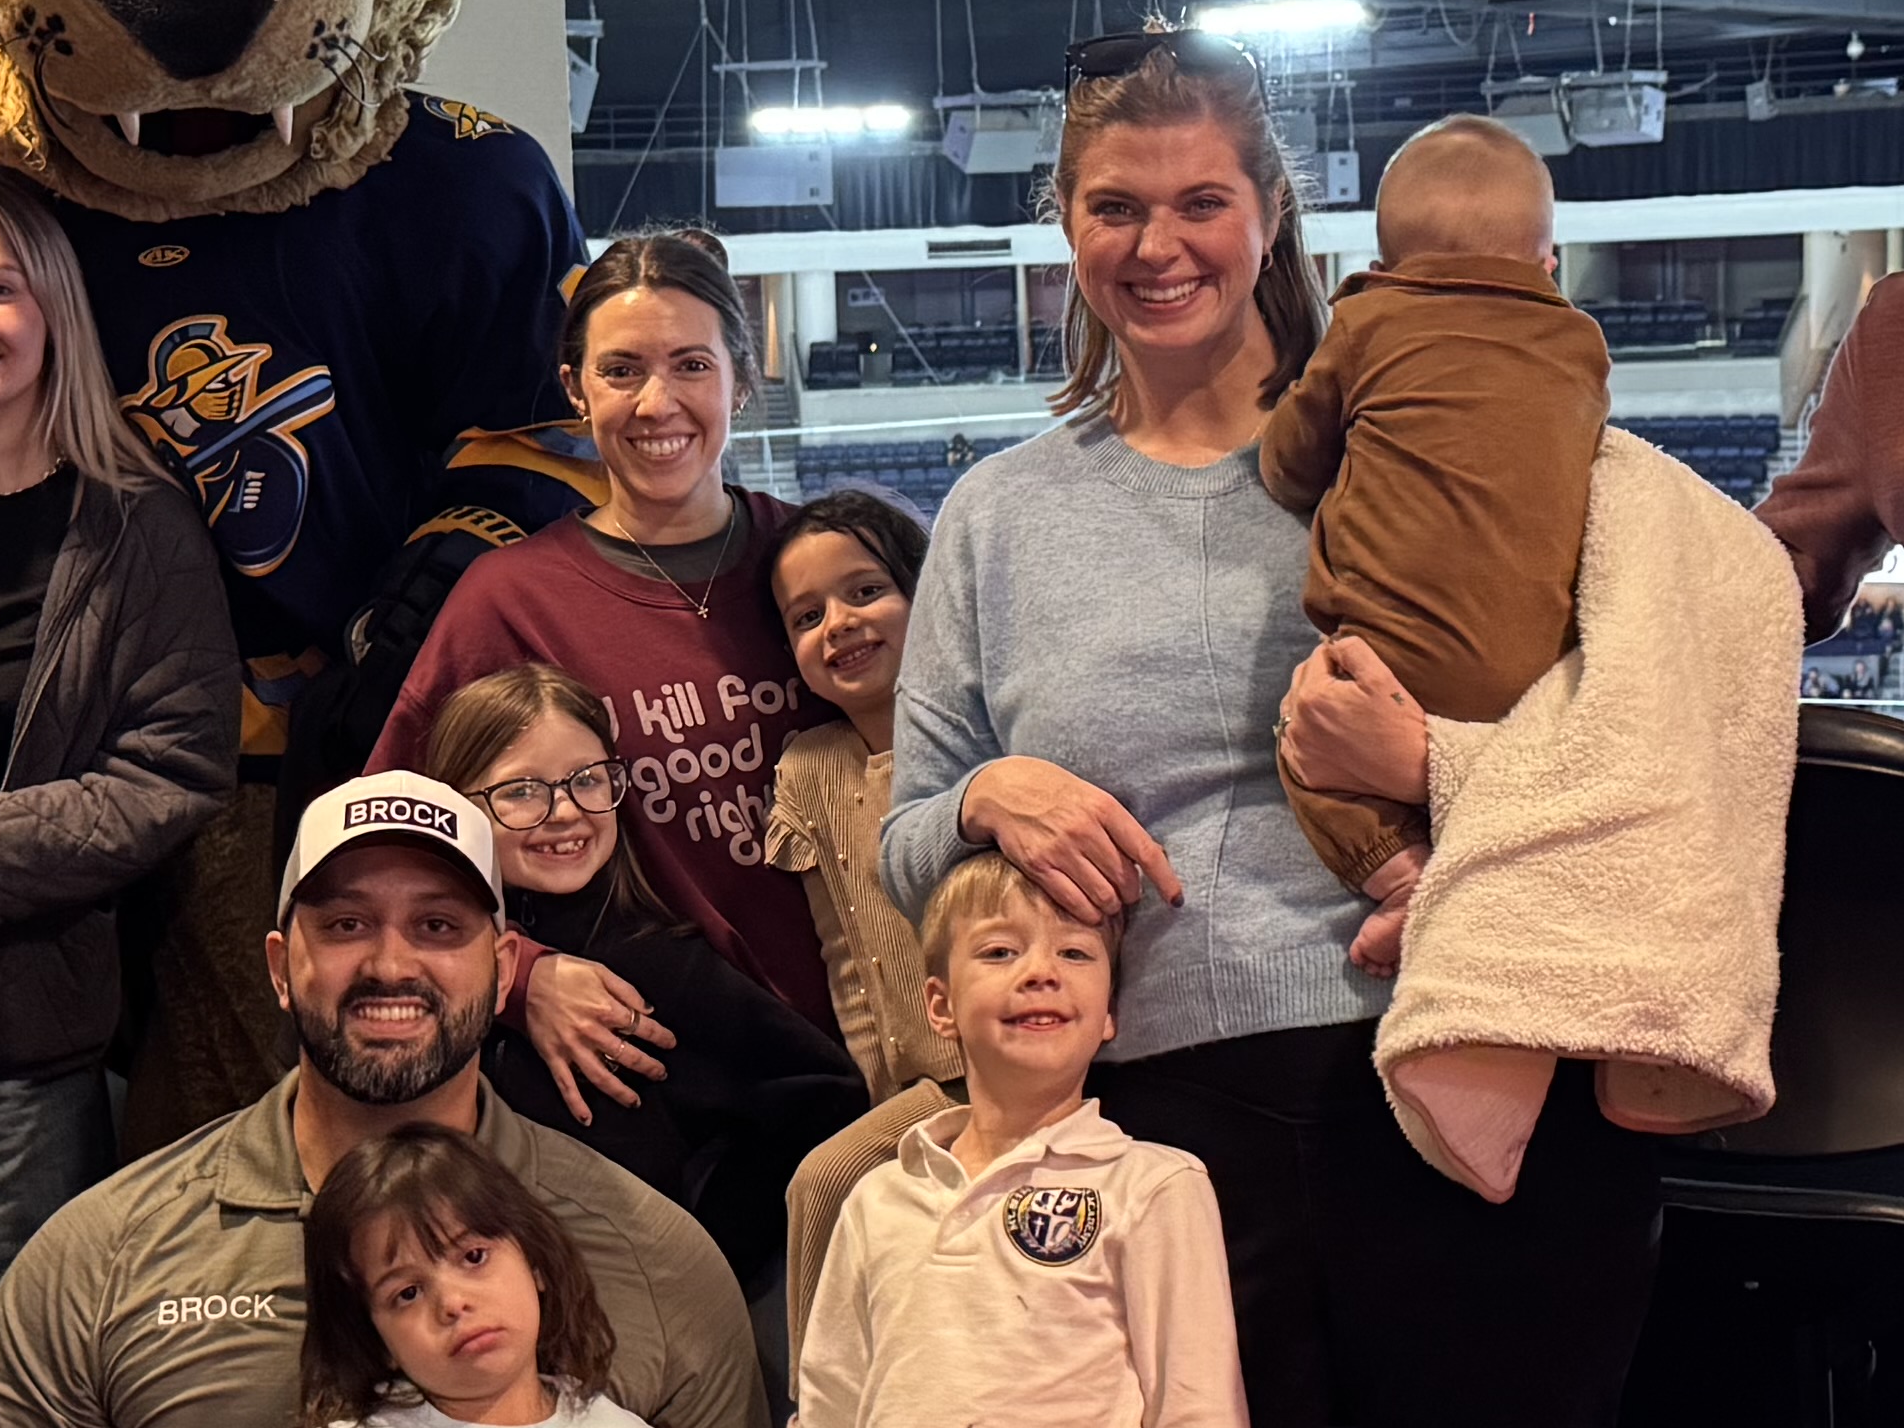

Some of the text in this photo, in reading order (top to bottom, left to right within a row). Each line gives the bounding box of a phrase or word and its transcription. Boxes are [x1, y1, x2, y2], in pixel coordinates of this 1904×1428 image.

[632, 681, 706, 743] kill
[631, 723, 764, 823] good
[350, 800, 452, 834] BROCK
[158, 1294, 276, 1325] BROCK
